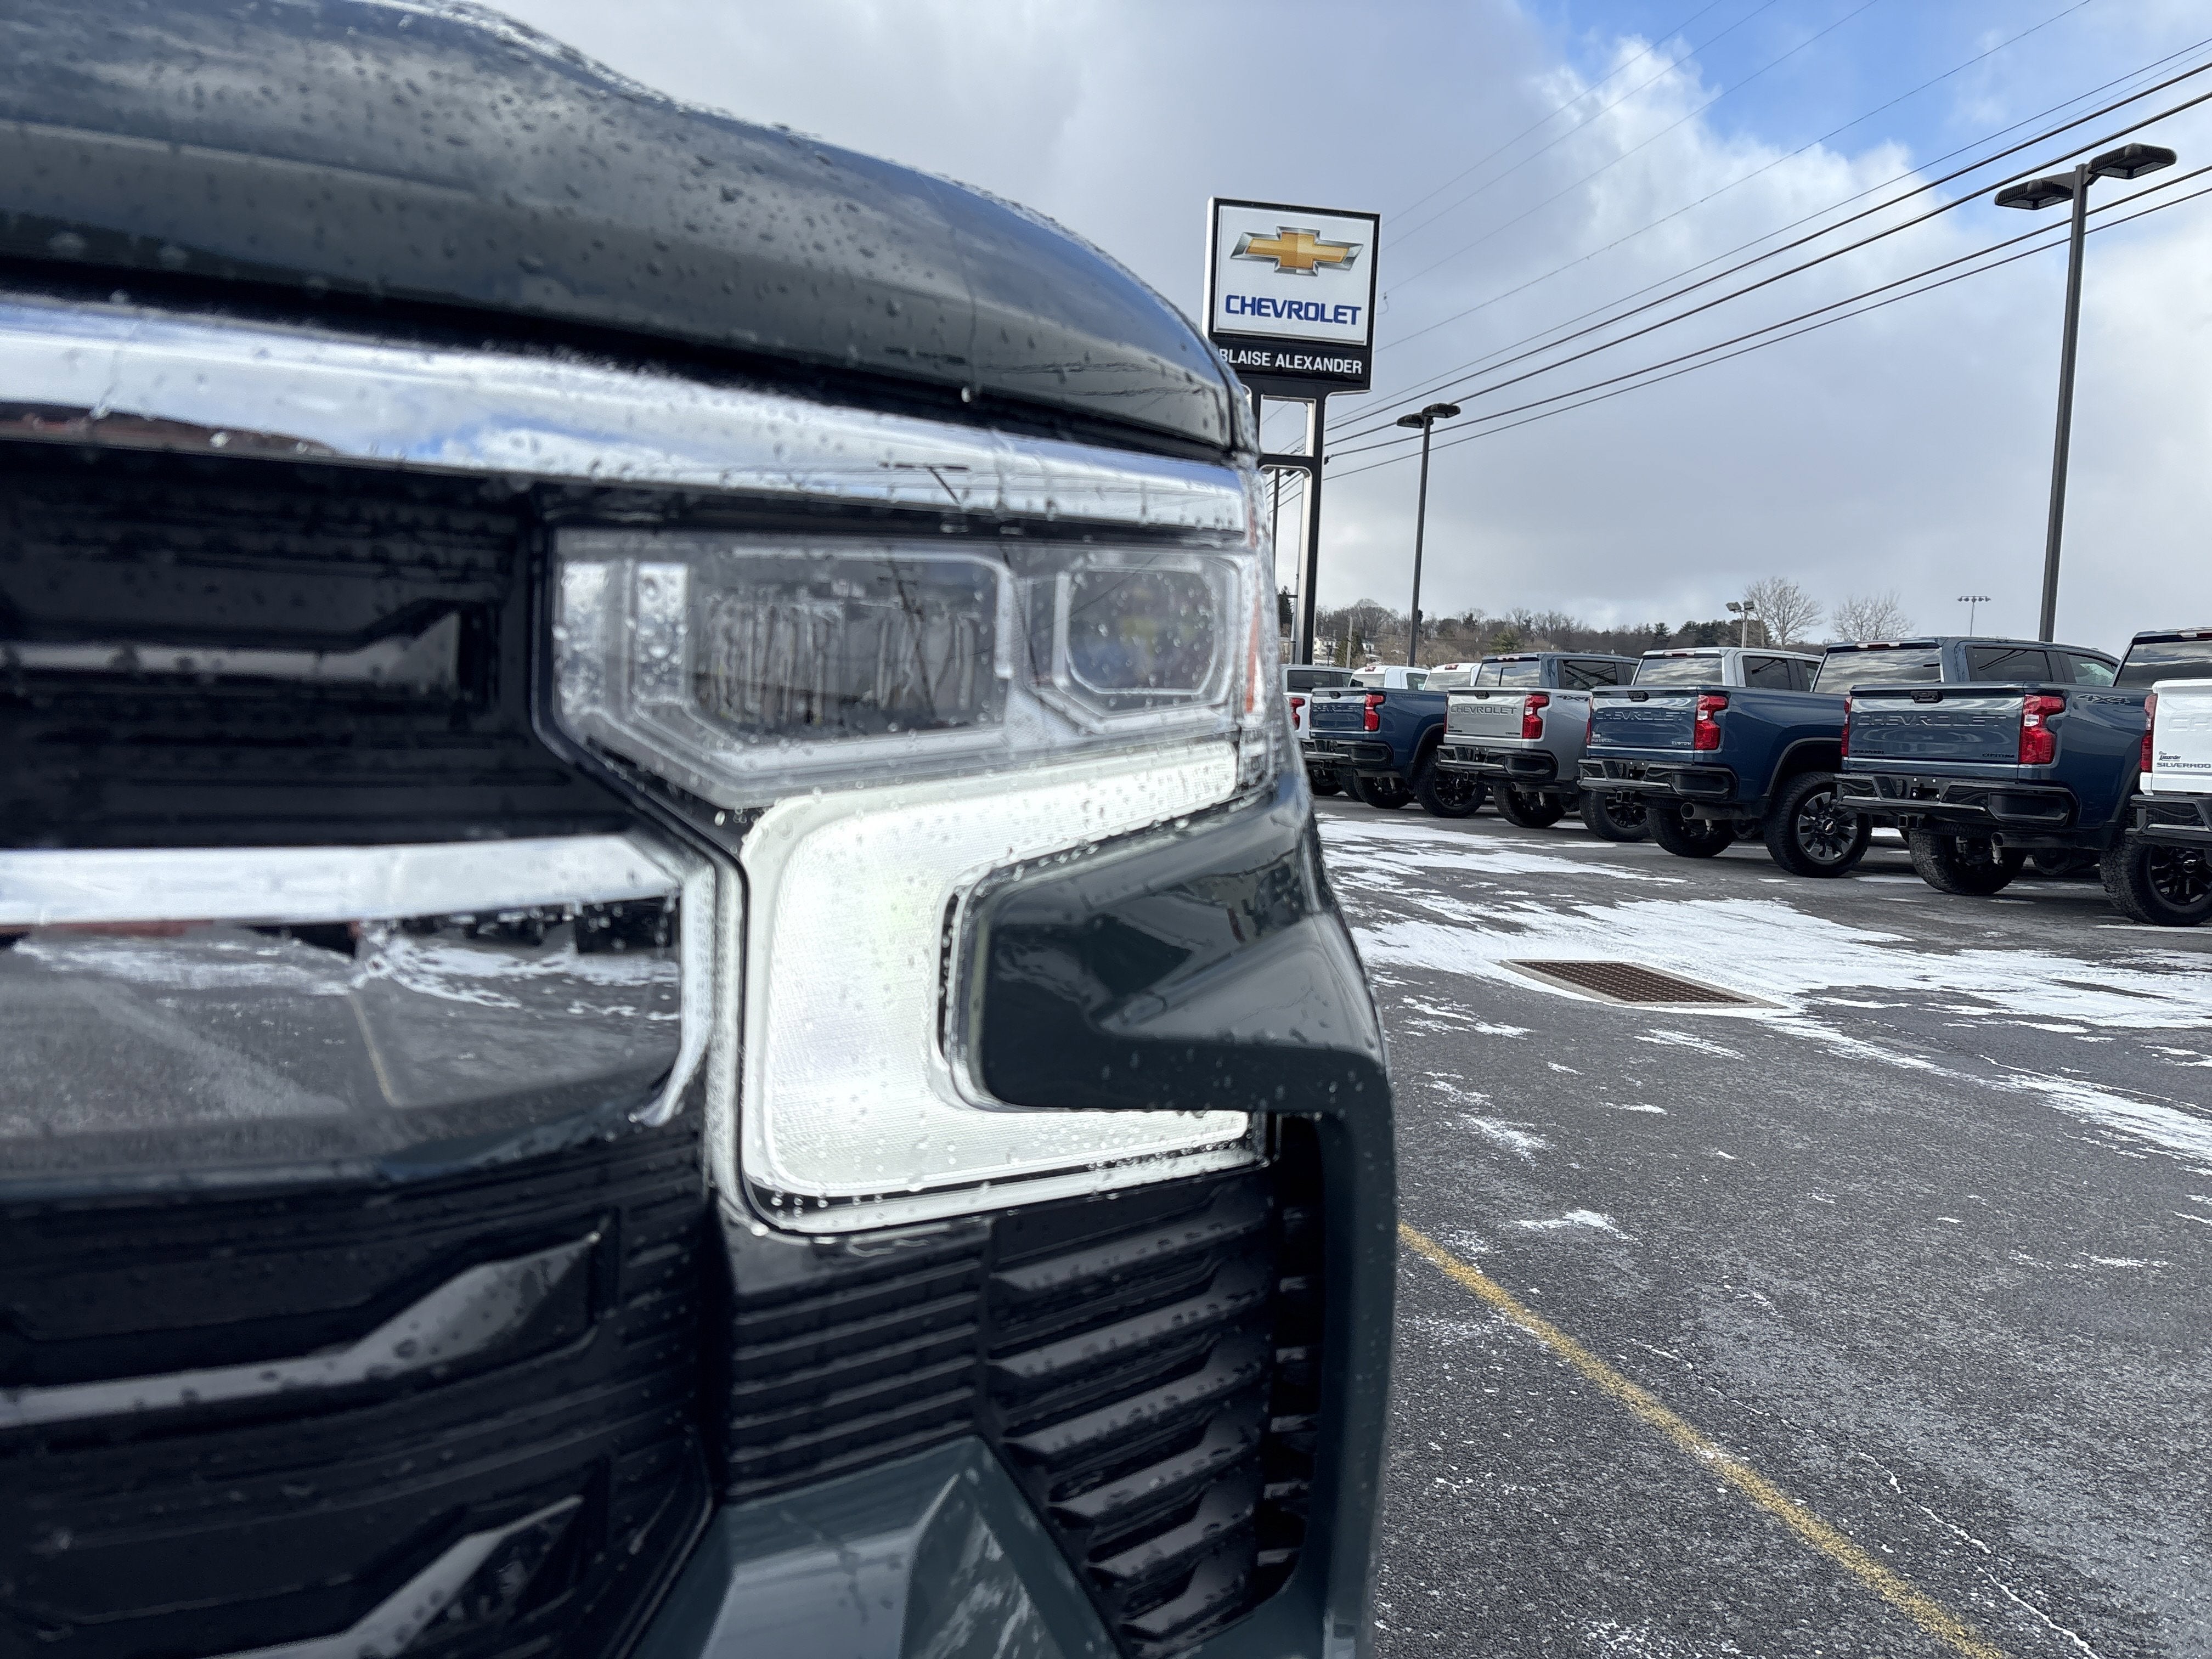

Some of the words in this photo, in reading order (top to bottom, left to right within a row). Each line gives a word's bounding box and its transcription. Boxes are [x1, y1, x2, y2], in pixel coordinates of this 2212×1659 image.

[1225, 295, 1362, 325] CHEVROLET
[1219, 348, 1271, 366] BLAISE
[1274, 353, 1362, 375] ALEXANDER
[1451, 706, 1517, 715] CHEVROLET
[1857, 715, 2007, 727] CHEVROLET
